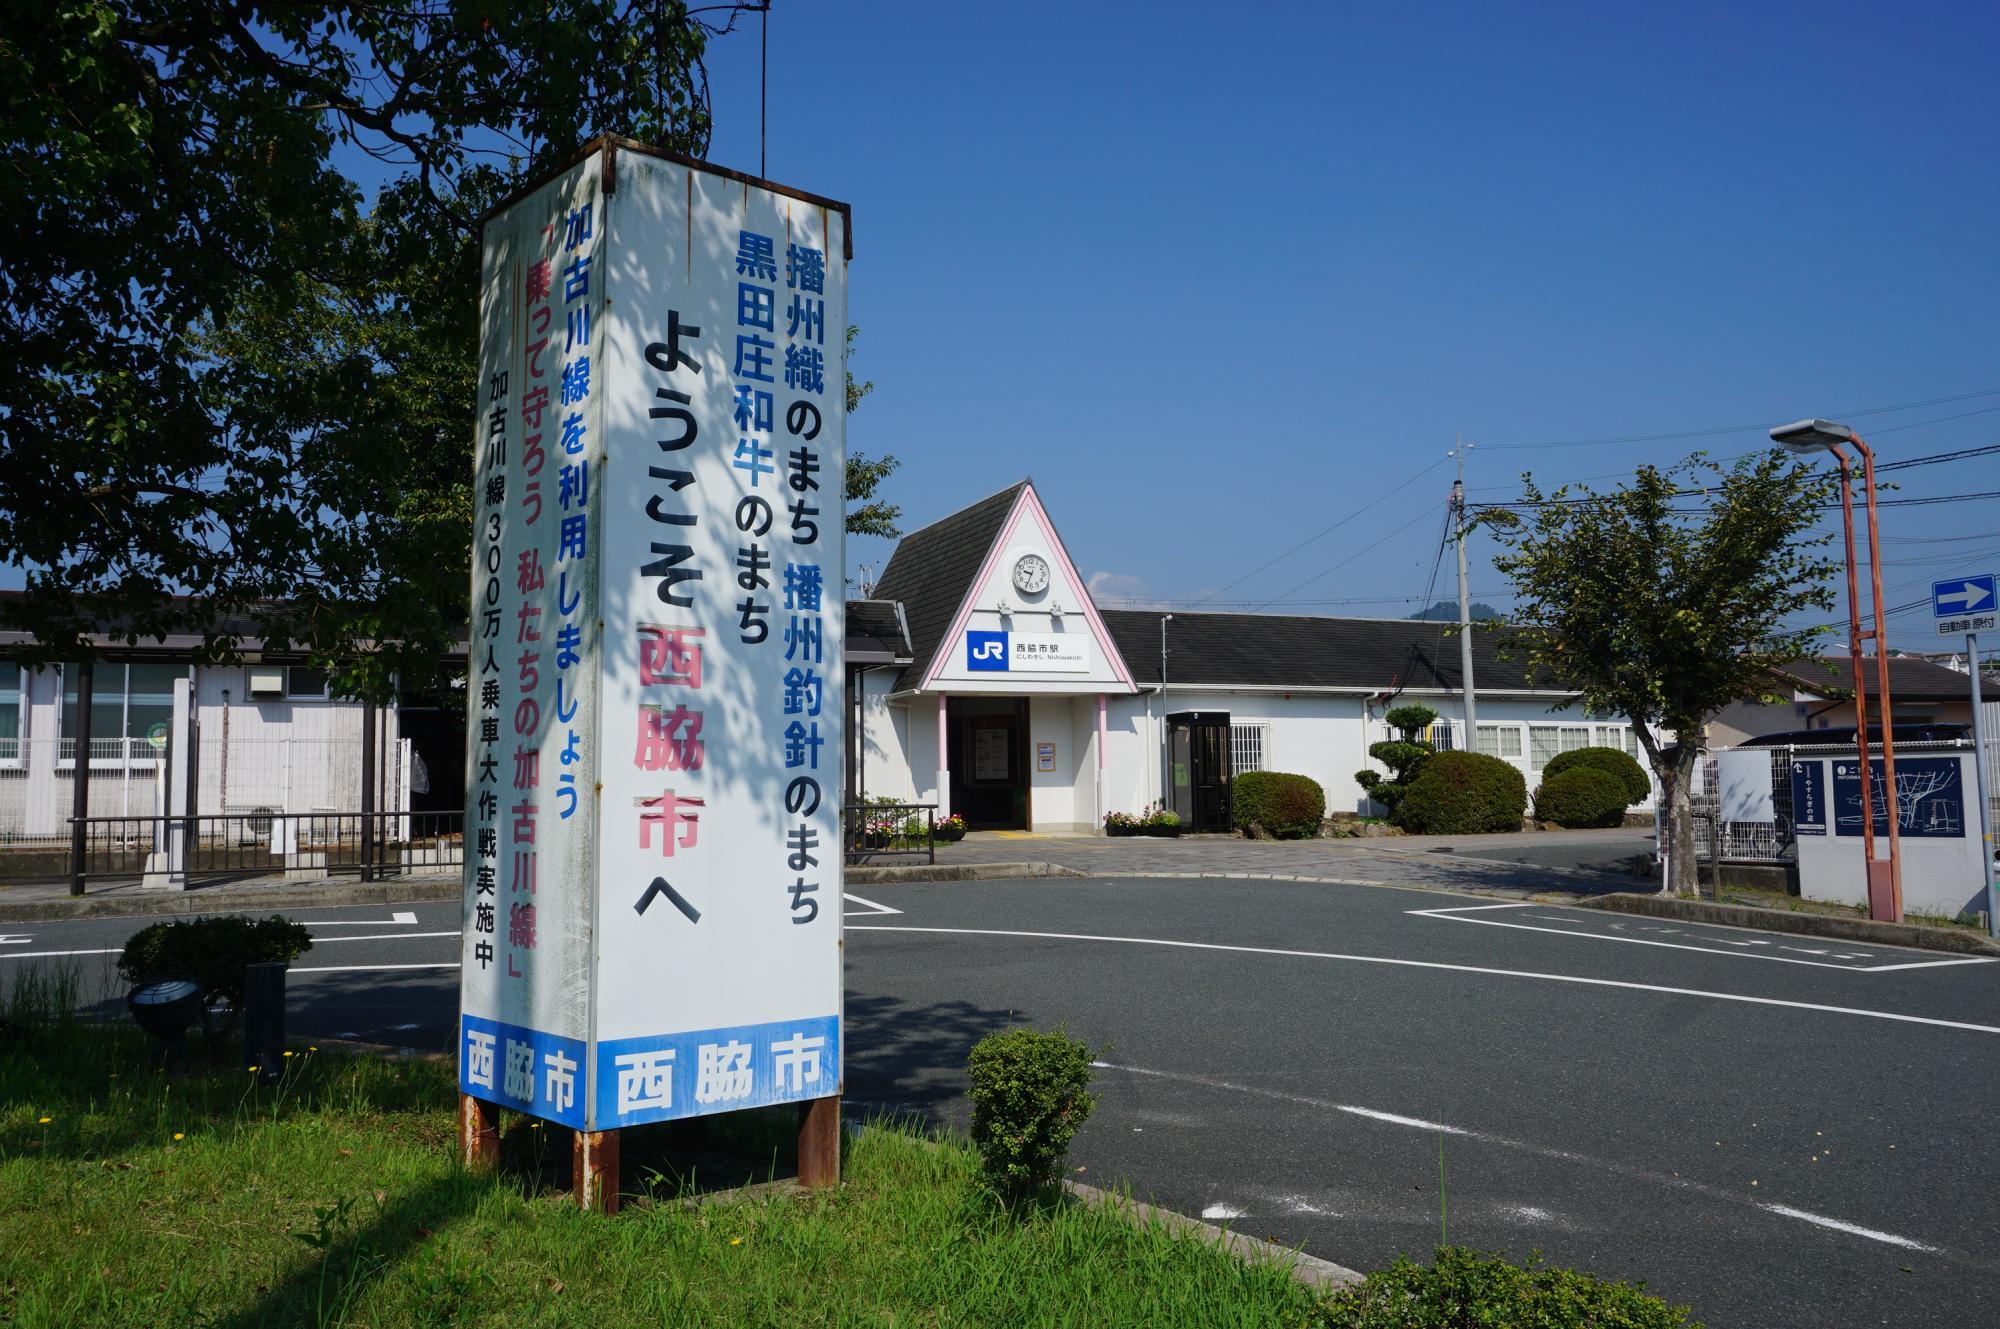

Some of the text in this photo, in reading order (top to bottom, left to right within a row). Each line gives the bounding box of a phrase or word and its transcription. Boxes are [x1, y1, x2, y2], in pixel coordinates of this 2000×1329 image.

[734, 231, 778, 645] 黒田庄和牛のまち
[556, 203, 592, 819] 加古川線を利用しましょう
[783, 244, 825, 925] 播州織のまち 播州釣針のまち
[973, 641, 1004, 660] JR
[1016, 643, 1059, 653] 西脇市駅
[468, 1031, 577, 1114] 西脇市
[615, 1033, 825, 1114] 西脇市
